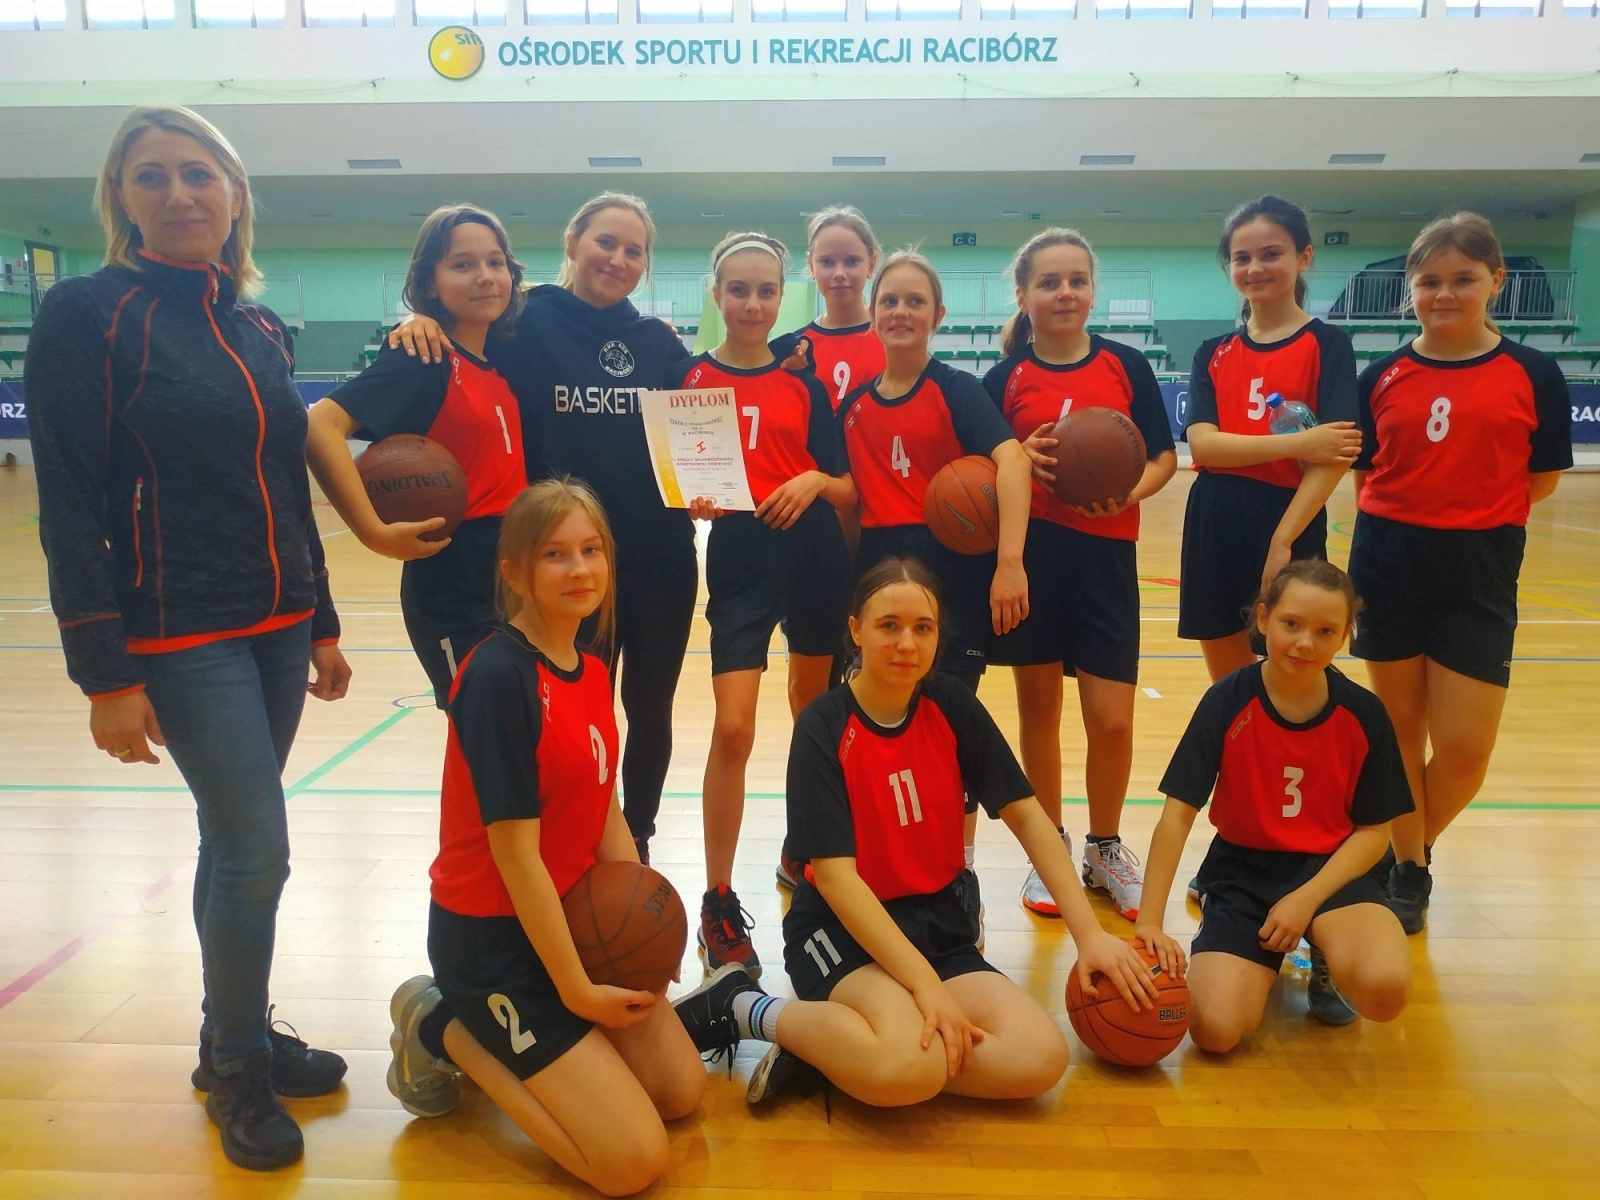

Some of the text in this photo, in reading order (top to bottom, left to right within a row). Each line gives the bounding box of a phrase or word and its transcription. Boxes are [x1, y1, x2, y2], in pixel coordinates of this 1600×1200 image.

[498, 32, 1058, 66] OŚRODEK SPORTU I REKREACJI RACIBÓRZ
[555, 385, 663, 415] BASKET
[669, 393, 730, 408] DYPLOM
[833, 361, 851, 400] 9
[1247, 377, 1266, 421] 5
[0, 403, 27, 419] RZ
[495, 405, 512, 454] 1
[742, 405, 760, 450] 7
[1426, 397, 1451, 443] 8
[891, 435, 911, 479] 4
[588, 724, 609, 785] 2
[888, 768, 924, 827] 11
[1282, 766, 1305, 818] 3
[803, 928, 844, 979] 11
[487, 993, 538, 1055] 2
